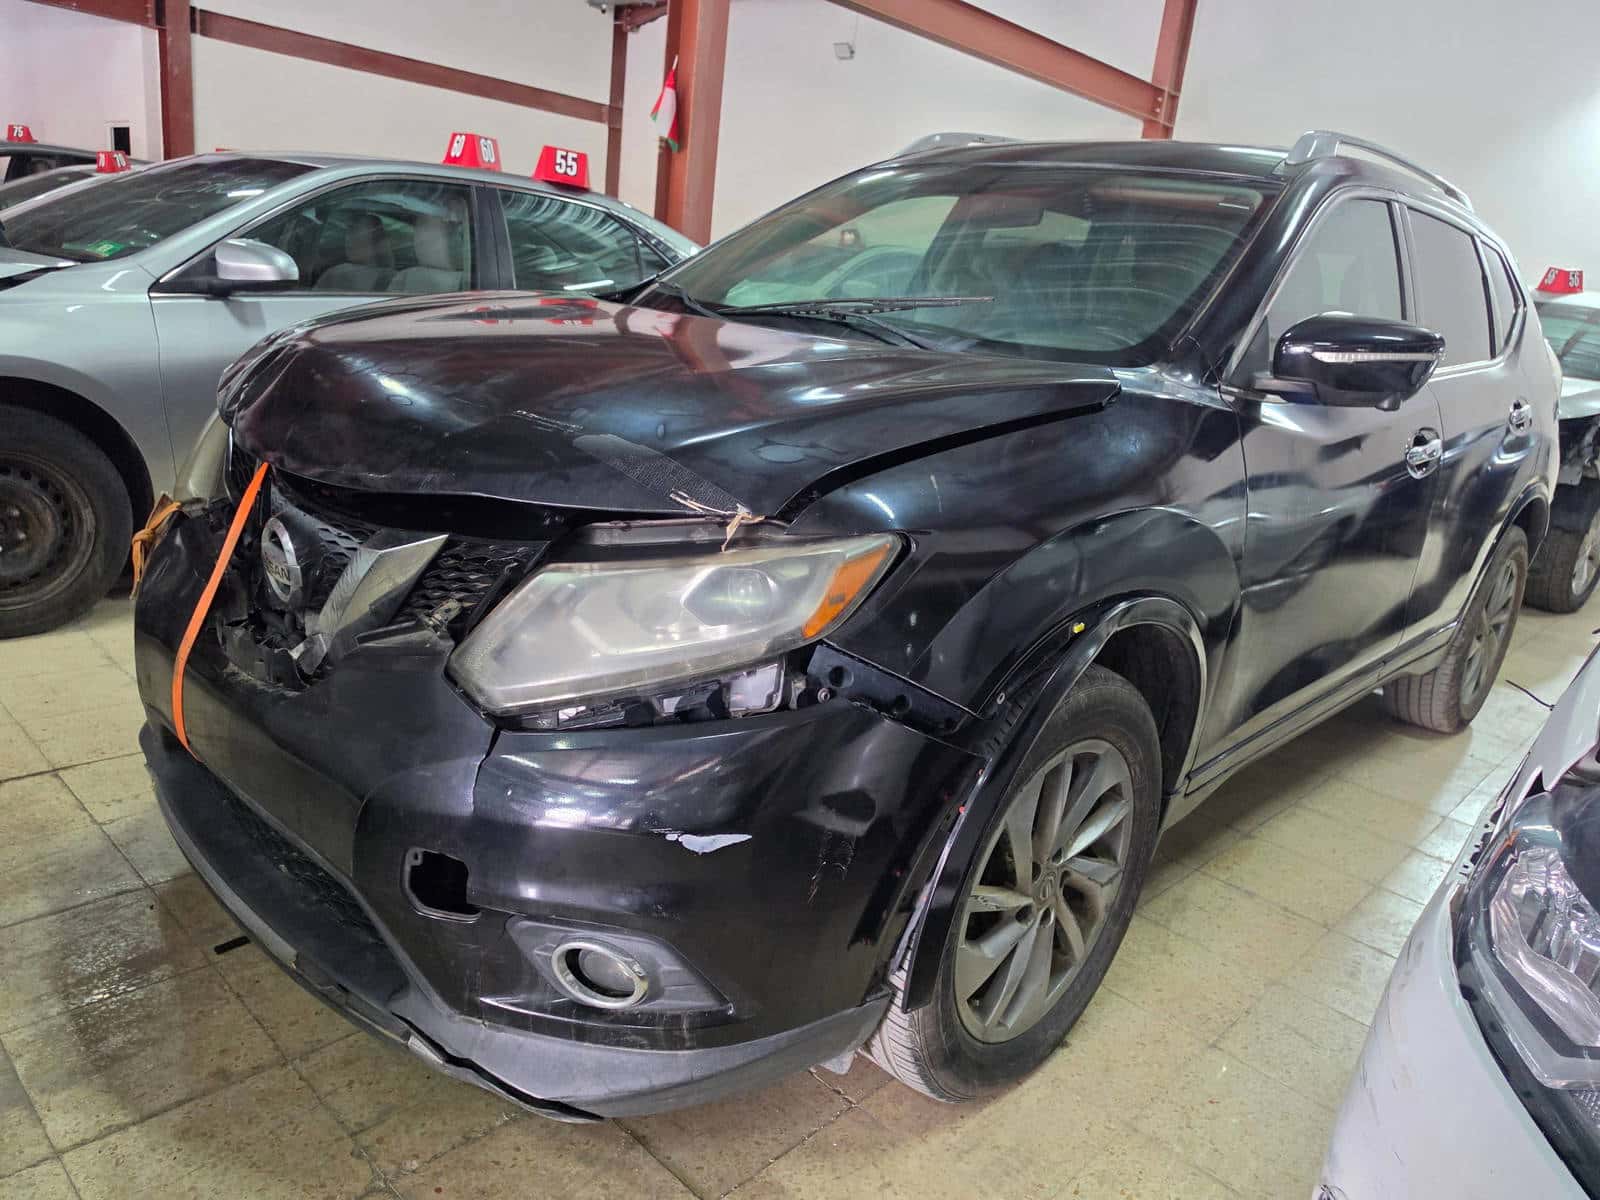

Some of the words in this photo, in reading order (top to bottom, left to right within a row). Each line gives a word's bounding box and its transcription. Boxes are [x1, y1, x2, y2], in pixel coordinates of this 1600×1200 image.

[13, 126, 24, 138] 75
[479, 138, 496, 164] 60
[555, 149, 578, 176] 55
